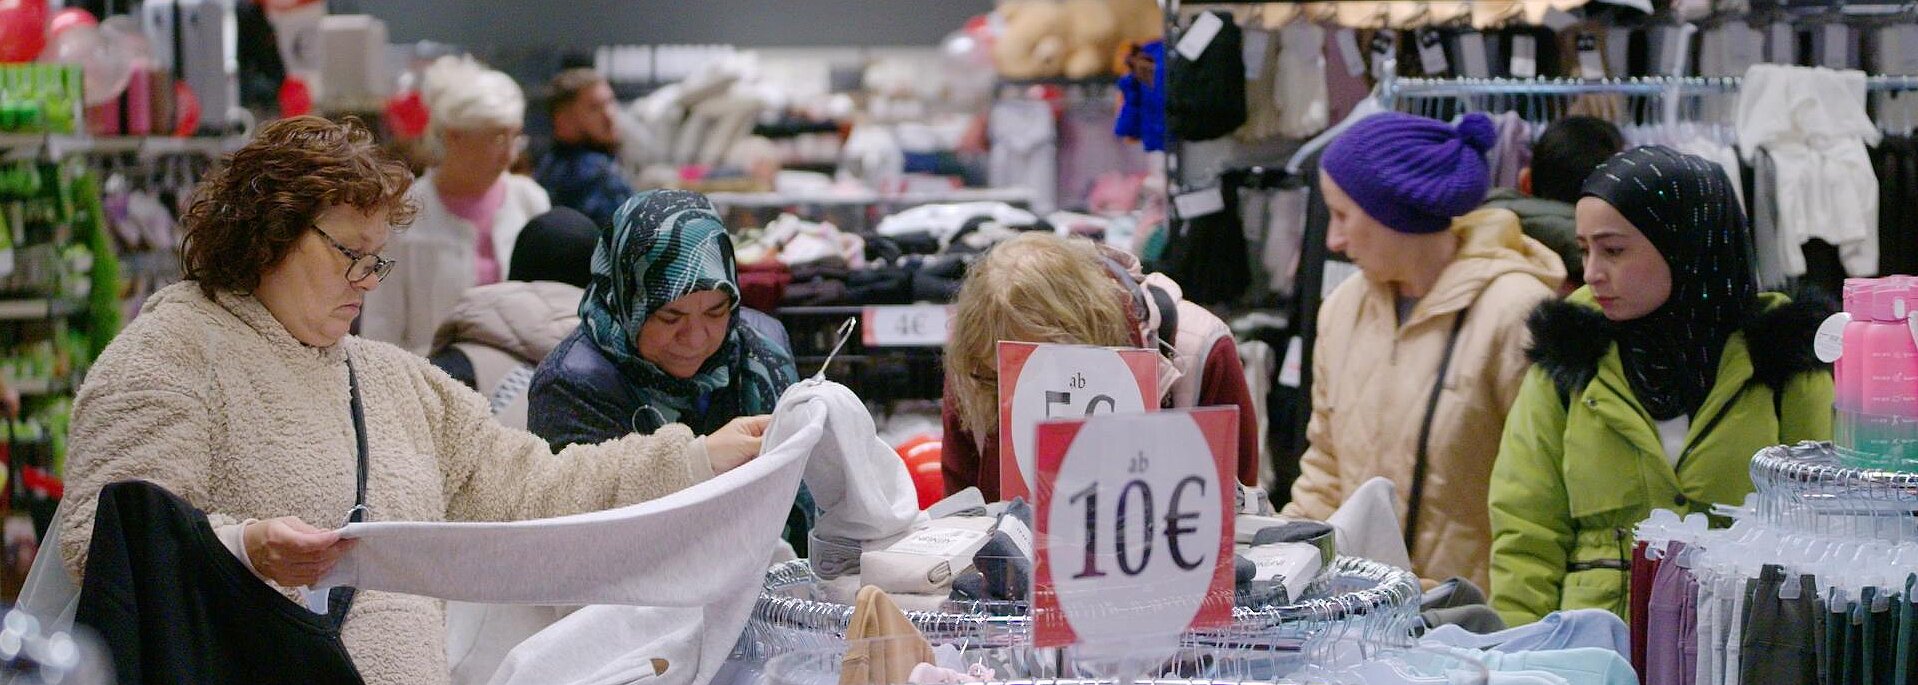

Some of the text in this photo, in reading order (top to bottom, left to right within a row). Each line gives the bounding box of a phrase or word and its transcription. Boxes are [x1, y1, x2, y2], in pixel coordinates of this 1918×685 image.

[894, 312, 929, 335] 4€
[1069, 372, 1086, 389] ab
[1127, 451, 1149, 474] ab
[1069, 474, 1206, 580] 10€
